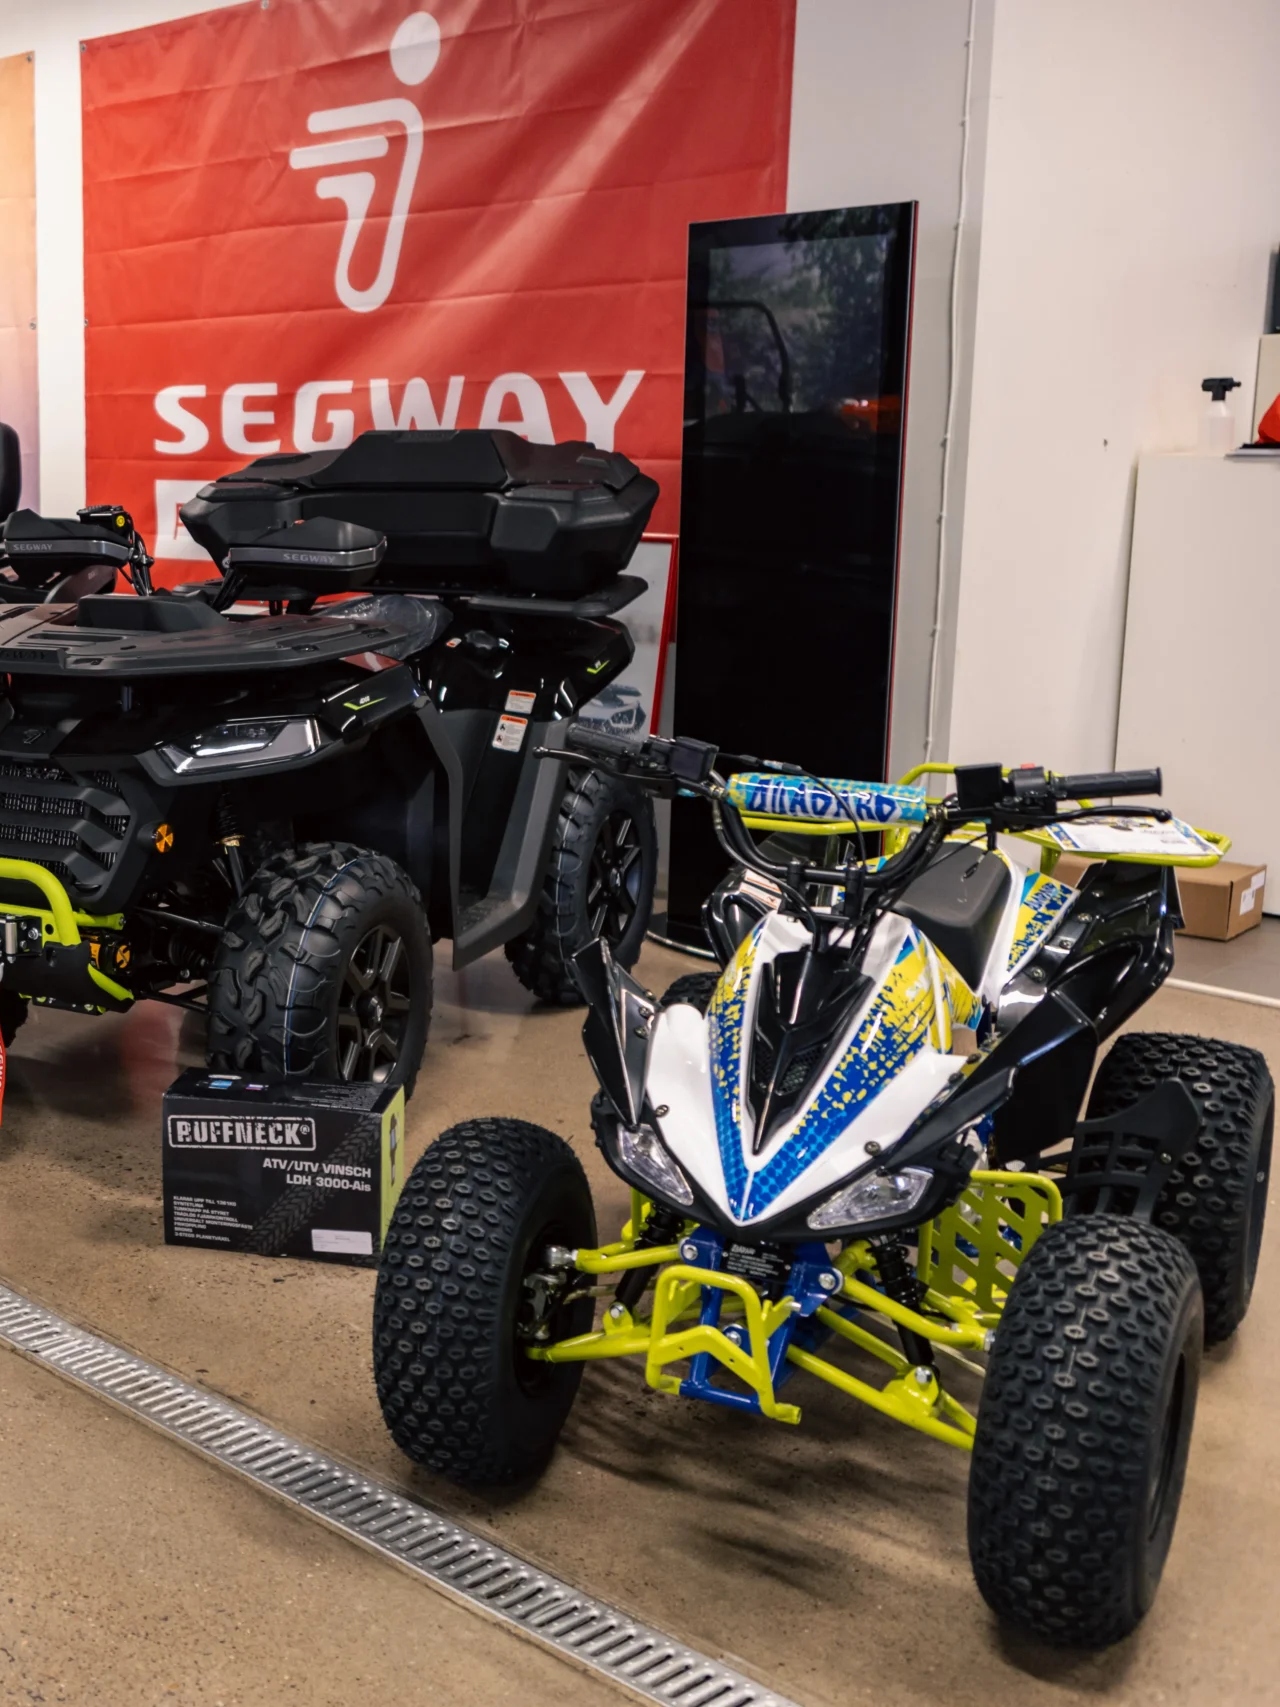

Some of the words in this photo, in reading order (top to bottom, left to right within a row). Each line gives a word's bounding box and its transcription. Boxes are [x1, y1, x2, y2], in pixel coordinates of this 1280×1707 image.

[153, 370, 646, 455] SEGWAY
[283, 553, 336, 563] SEGWAY
[263, 1158, 319, 1172] ATV/UTV
[322, 1163, 372, 1178] VINSCH
[286, 1174, 312, 1185] LDH
[316, 1177, 372, 1192] 3000-Ais
